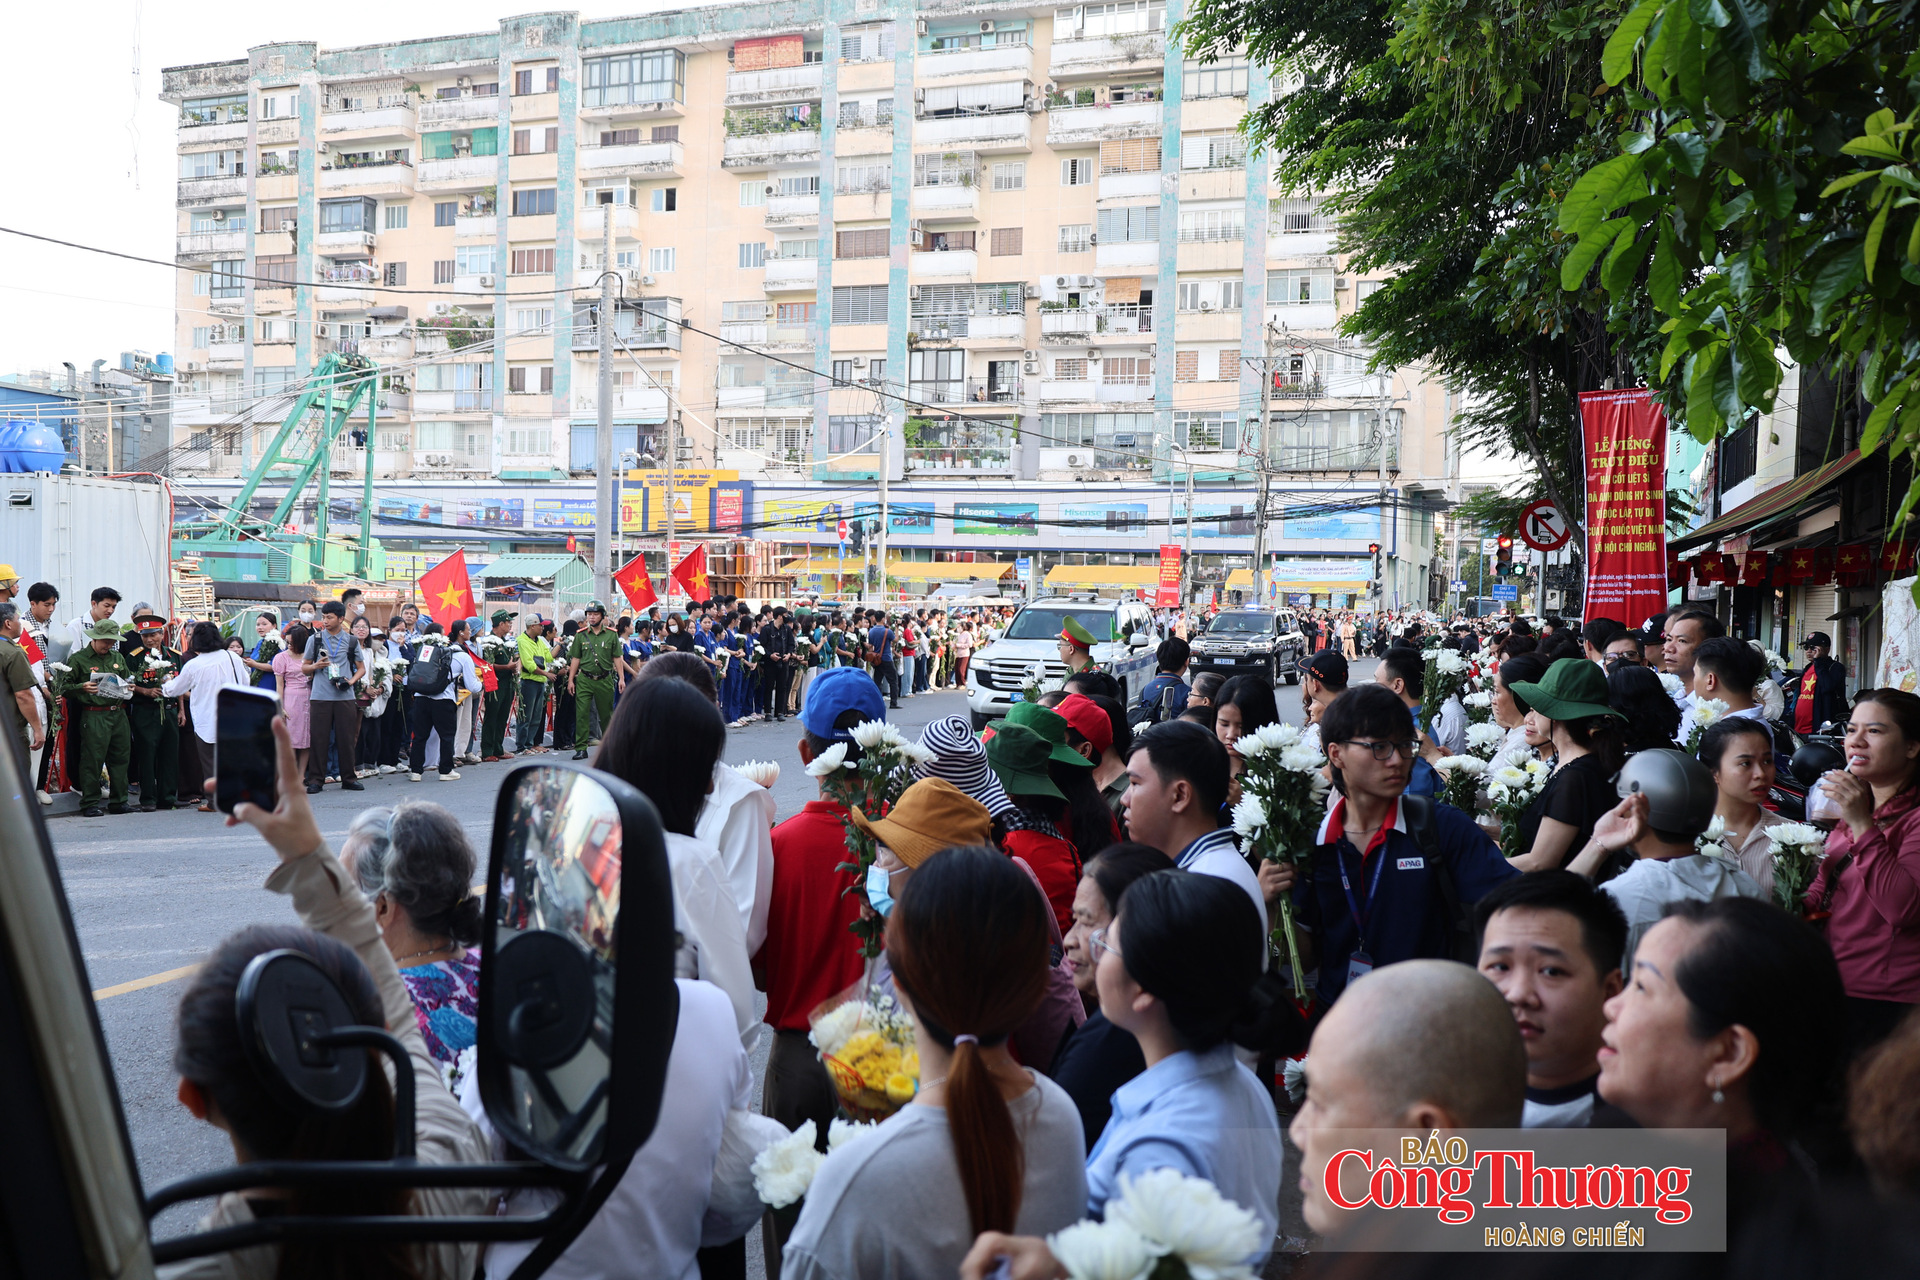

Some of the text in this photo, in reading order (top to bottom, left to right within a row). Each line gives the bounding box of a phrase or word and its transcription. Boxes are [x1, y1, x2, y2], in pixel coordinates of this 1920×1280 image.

[1595, 435, 1655, 453] LỄ VIẾNG,
[1591, 452, 1659, 469] TRUY ĐIỆU
[1612, 471, 1625, 484] CỐT
[1627, 472, 1641, 486] LIỆT
[1588, 491, 1598, 503] ĐÃ
[1614, 490, 1633, 502] DŨNG
[1634, 491, 1644, 501] HY
[1646, 490, 1664, 500] SINH
[959, 507, 995, 516] Hisense
[1064, 508, 1102, 517] Hisense
[1603, 507, 1617, 520] ĐỘC
[1634, 507, 1644, 520] TỰ
[1645, 507, 1655, 518] DO
[1611, 522, 1631, 537] QUỐC
[1631, 523, 1647, 537] VIỆT
[1648, 524, 1664, 535] NAM
[1604, 540, 1617, 554] HỘI
[1618, 539, 1633, 553] CHỦ
[1634, 540, 1657, 553] NGHĨA
[1399, 860, 1422, 869] APAG
